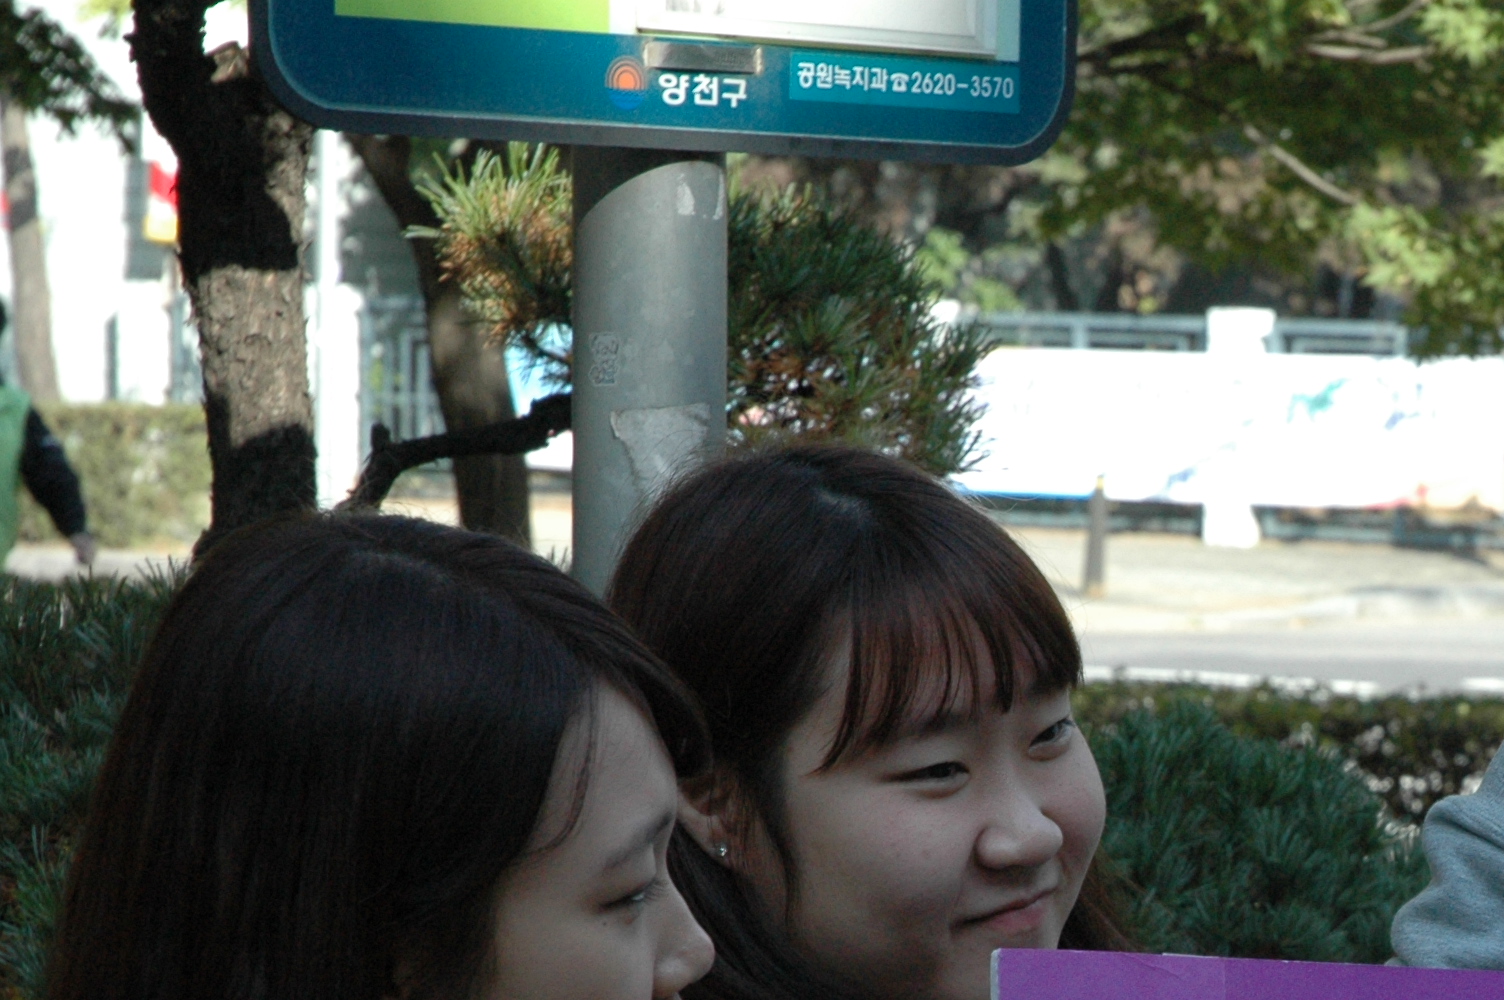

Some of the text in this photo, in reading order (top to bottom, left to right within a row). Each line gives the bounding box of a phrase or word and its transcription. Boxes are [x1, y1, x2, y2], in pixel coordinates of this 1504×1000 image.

[658, 73, 749, 109] 양천구
[797, 61, 1015, 100] 공원녹지과 2620-3570
